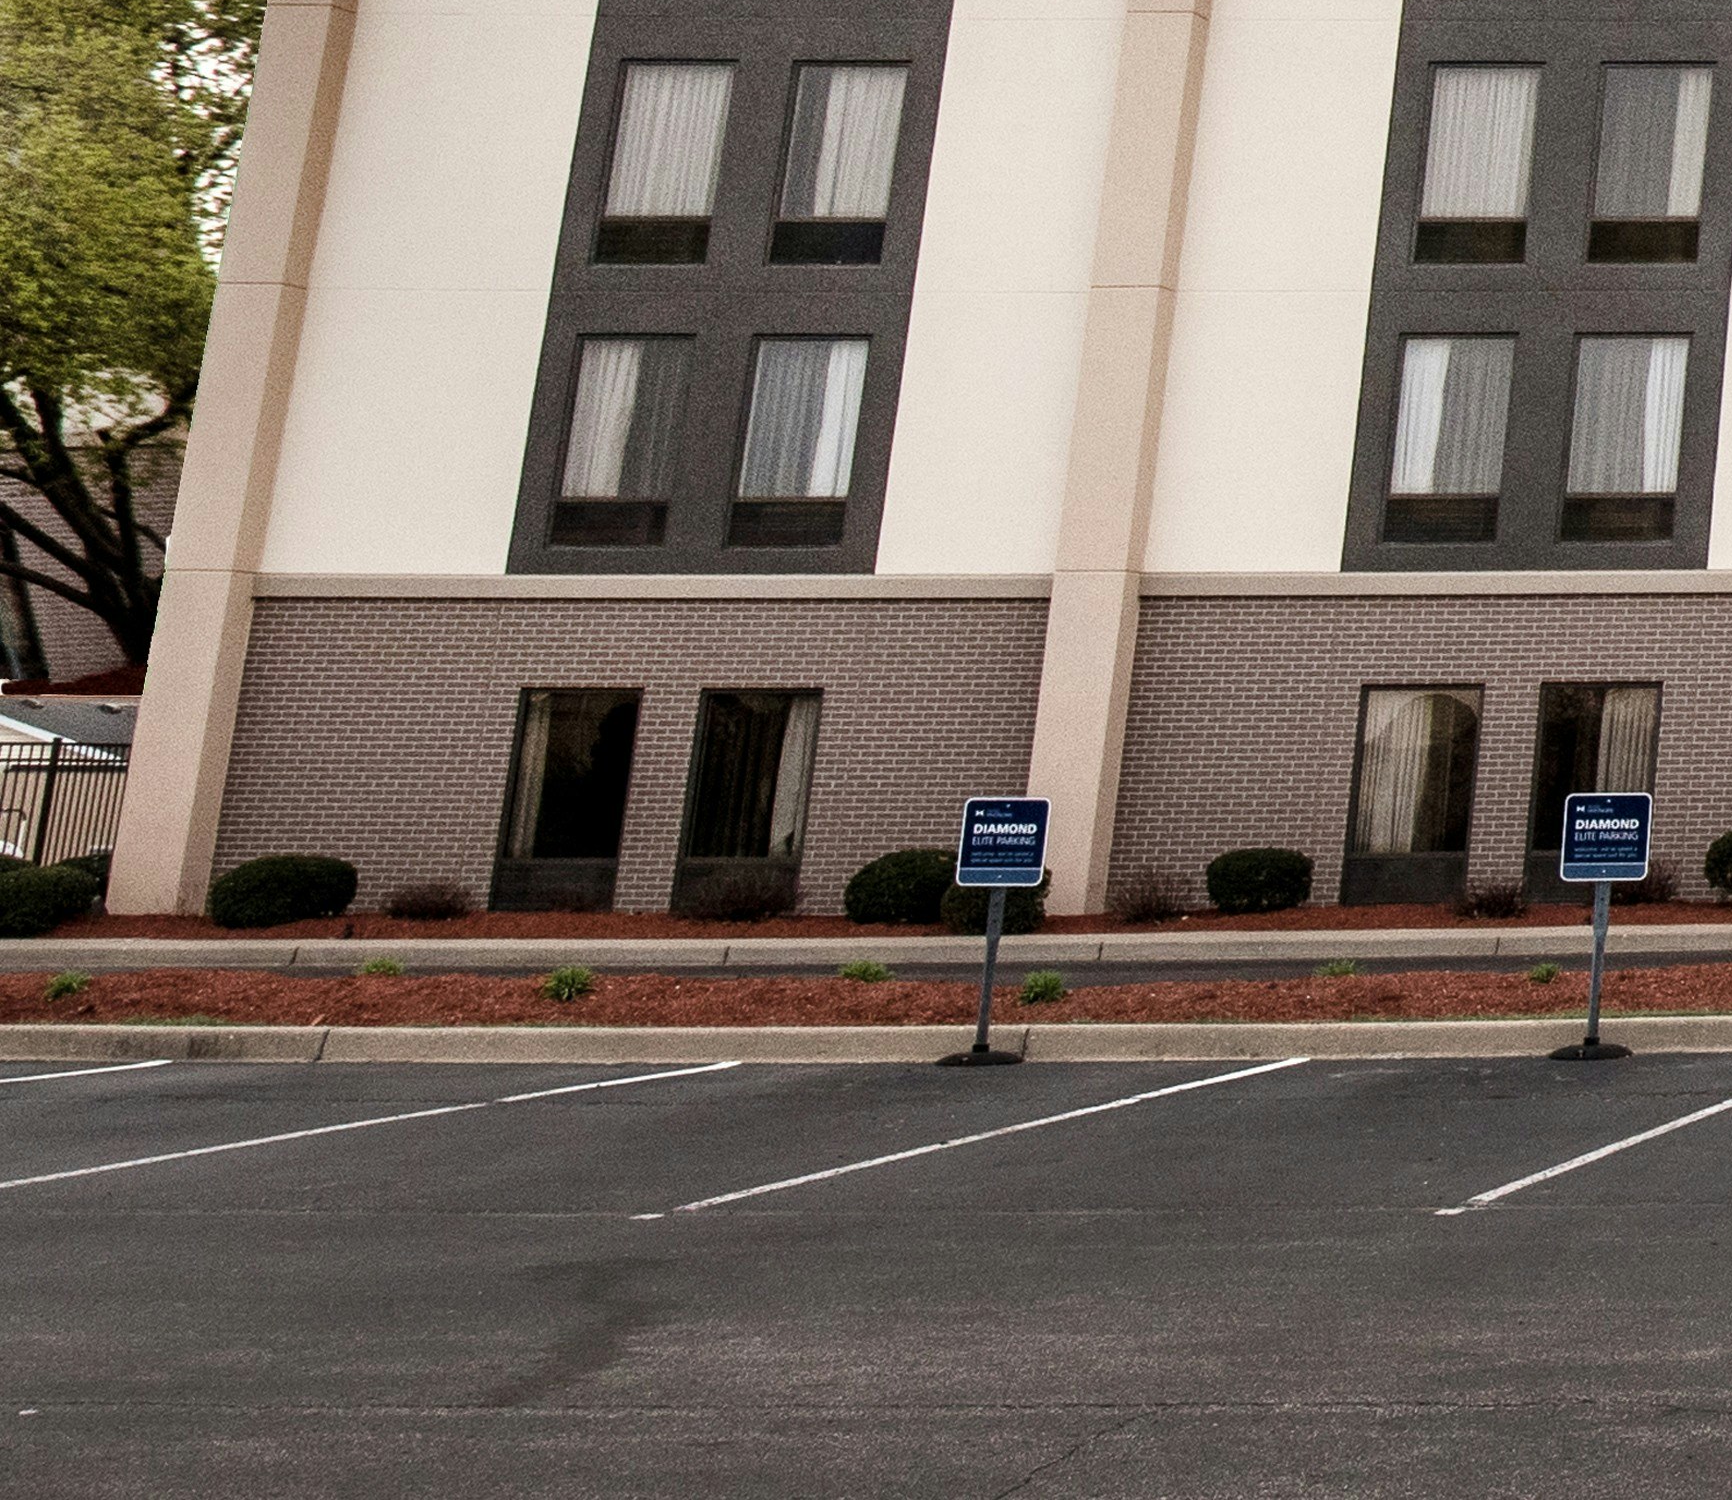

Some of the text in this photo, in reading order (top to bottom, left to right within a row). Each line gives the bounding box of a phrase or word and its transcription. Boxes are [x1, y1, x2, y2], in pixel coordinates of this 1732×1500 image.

[973, 823, 1038, 835] DIAMOND
[1575, 818, 1640, 830] DIAMOND
[971, 836, 1037, 846] ELITE PARKING
[1574, 831, 1639, 841] ELITE PARKING
